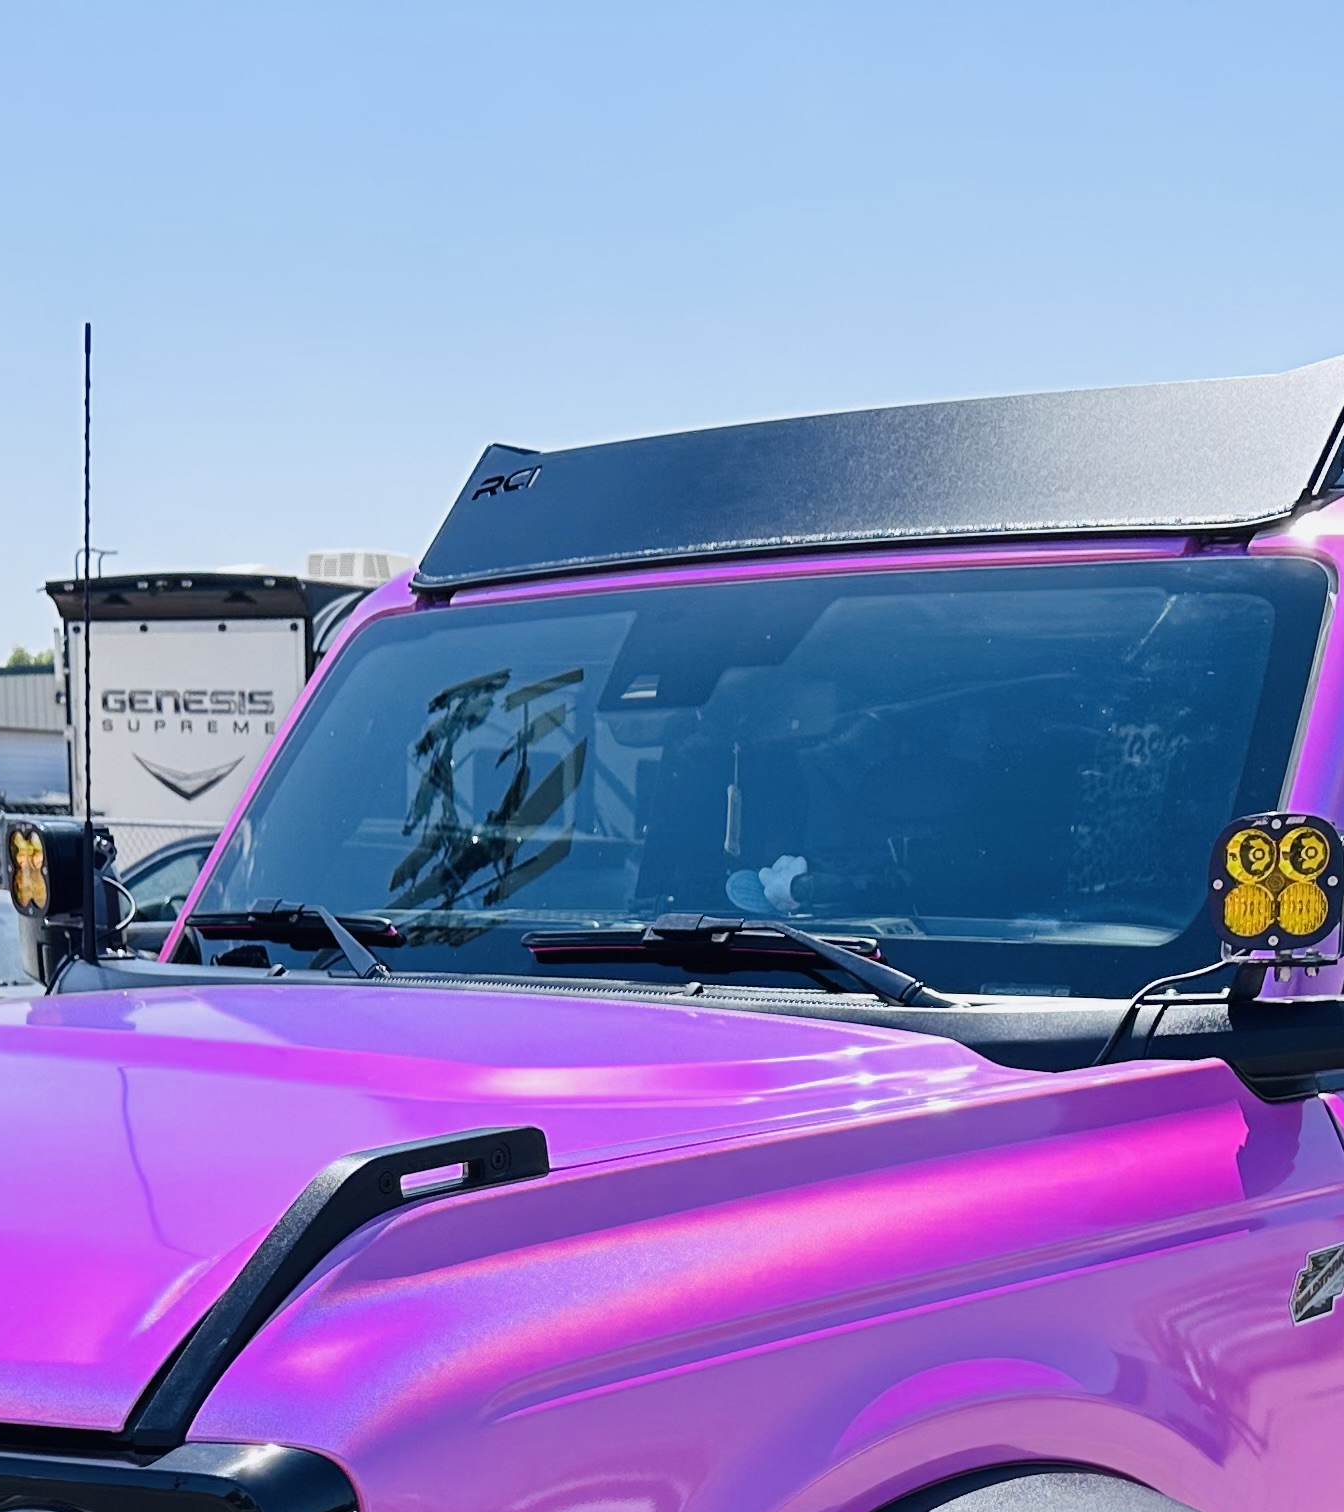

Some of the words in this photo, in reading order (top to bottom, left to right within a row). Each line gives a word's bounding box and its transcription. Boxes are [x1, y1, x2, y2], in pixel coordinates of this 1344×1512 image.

[471, 464, 543, 501] RCI
[101, 689, 275, 715] GENESIS
[101, 719, 276, 735] SUPREME
